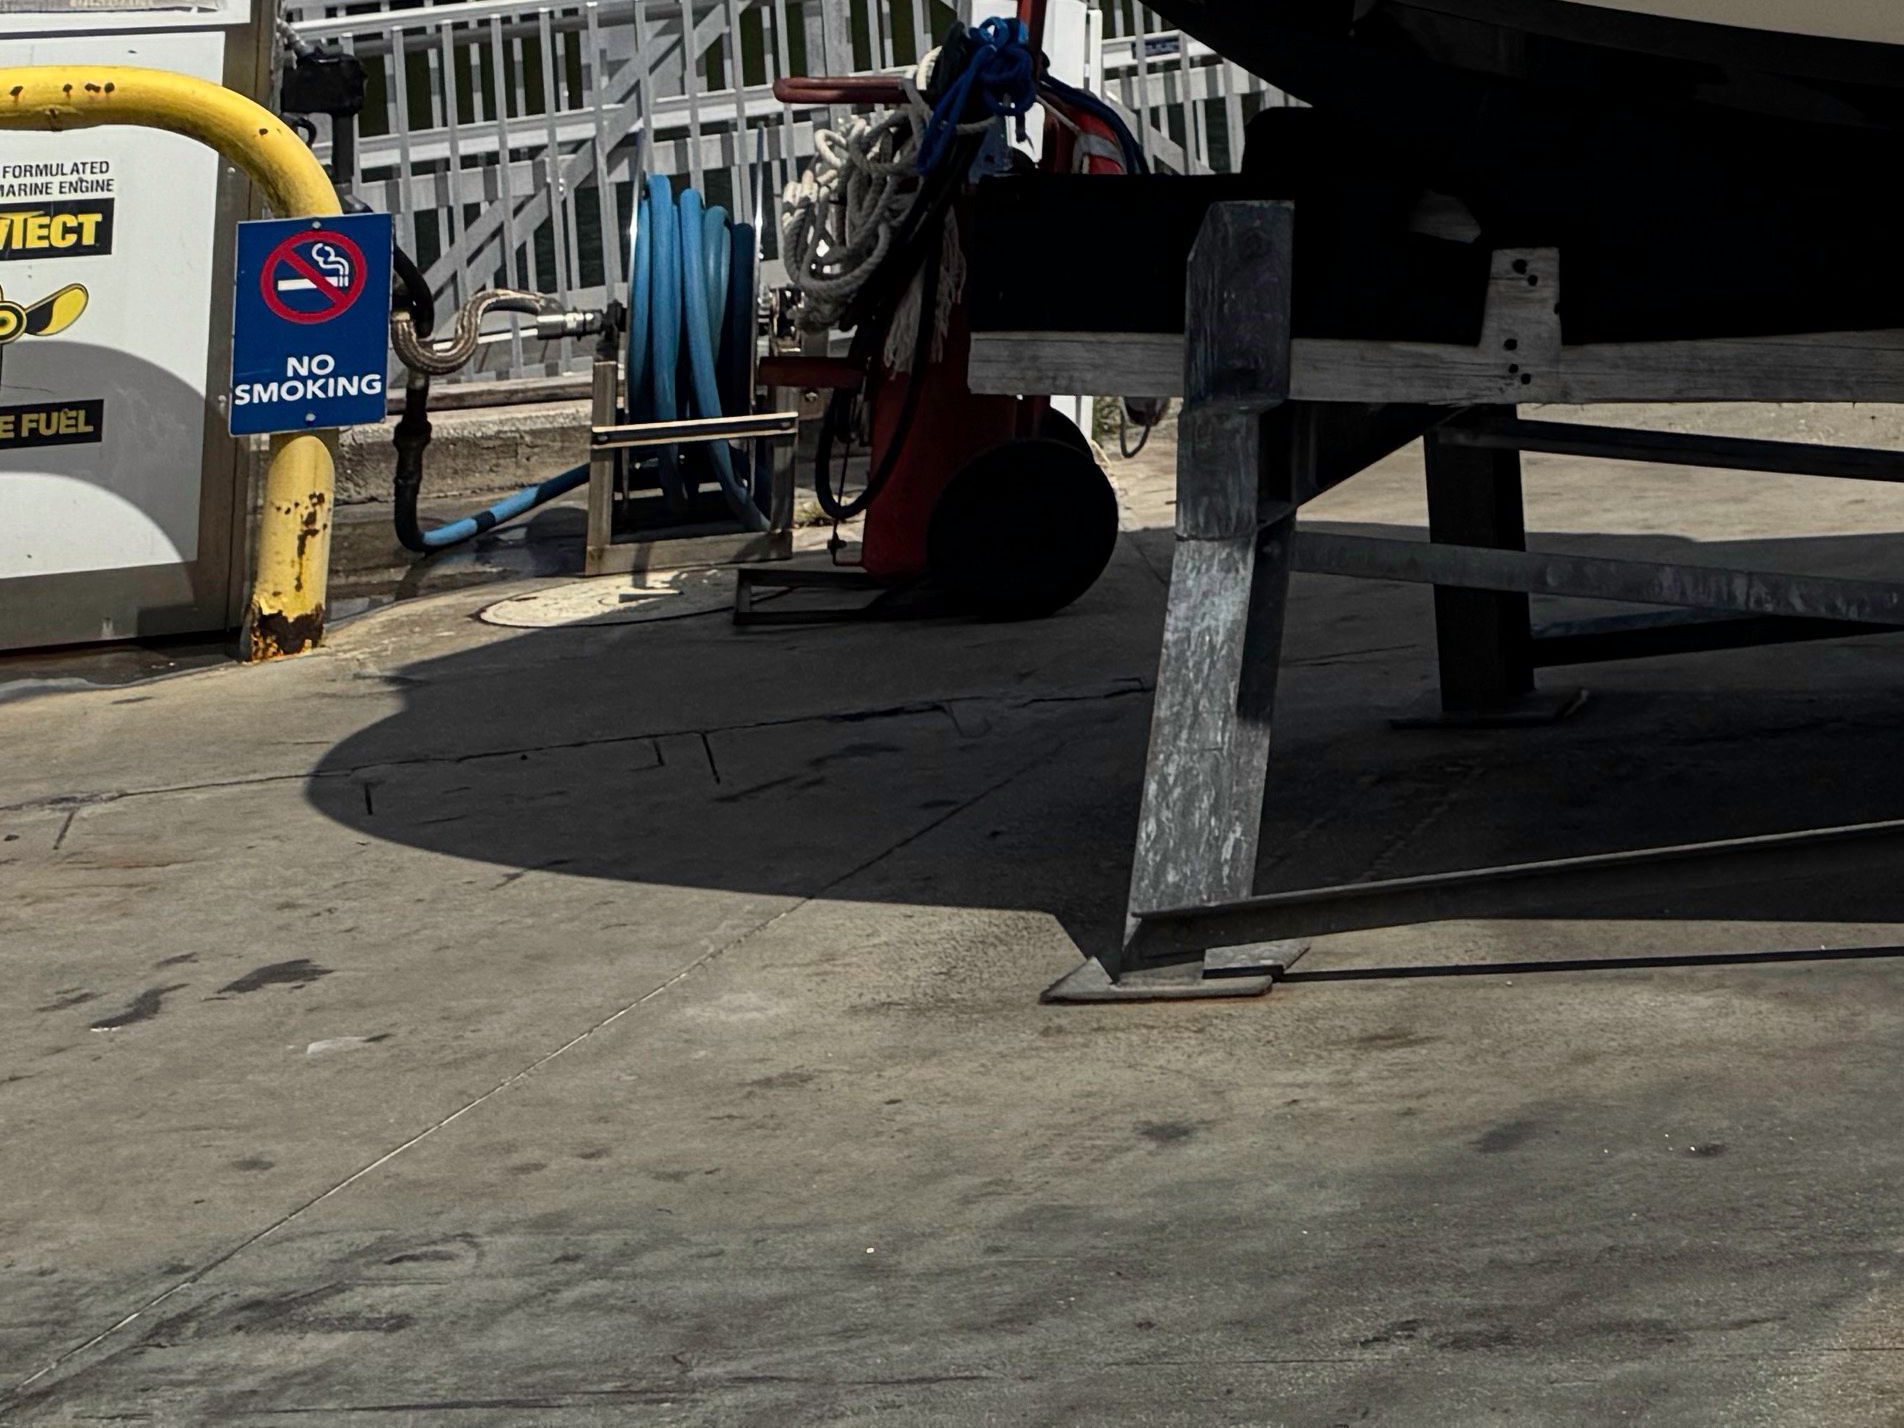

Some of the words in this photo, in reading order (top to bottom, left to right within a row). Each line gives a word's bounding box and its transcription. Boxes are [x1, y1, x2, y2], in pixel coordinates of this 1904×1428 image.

[2, 160, 110, 179] FORMULATED
[59, 178, 115, 195] ENGINE
[286, 354, 335, 377] NO
[234, 373, 382, 406] SMOKING
[21, 408, 94, 438] FUEL
